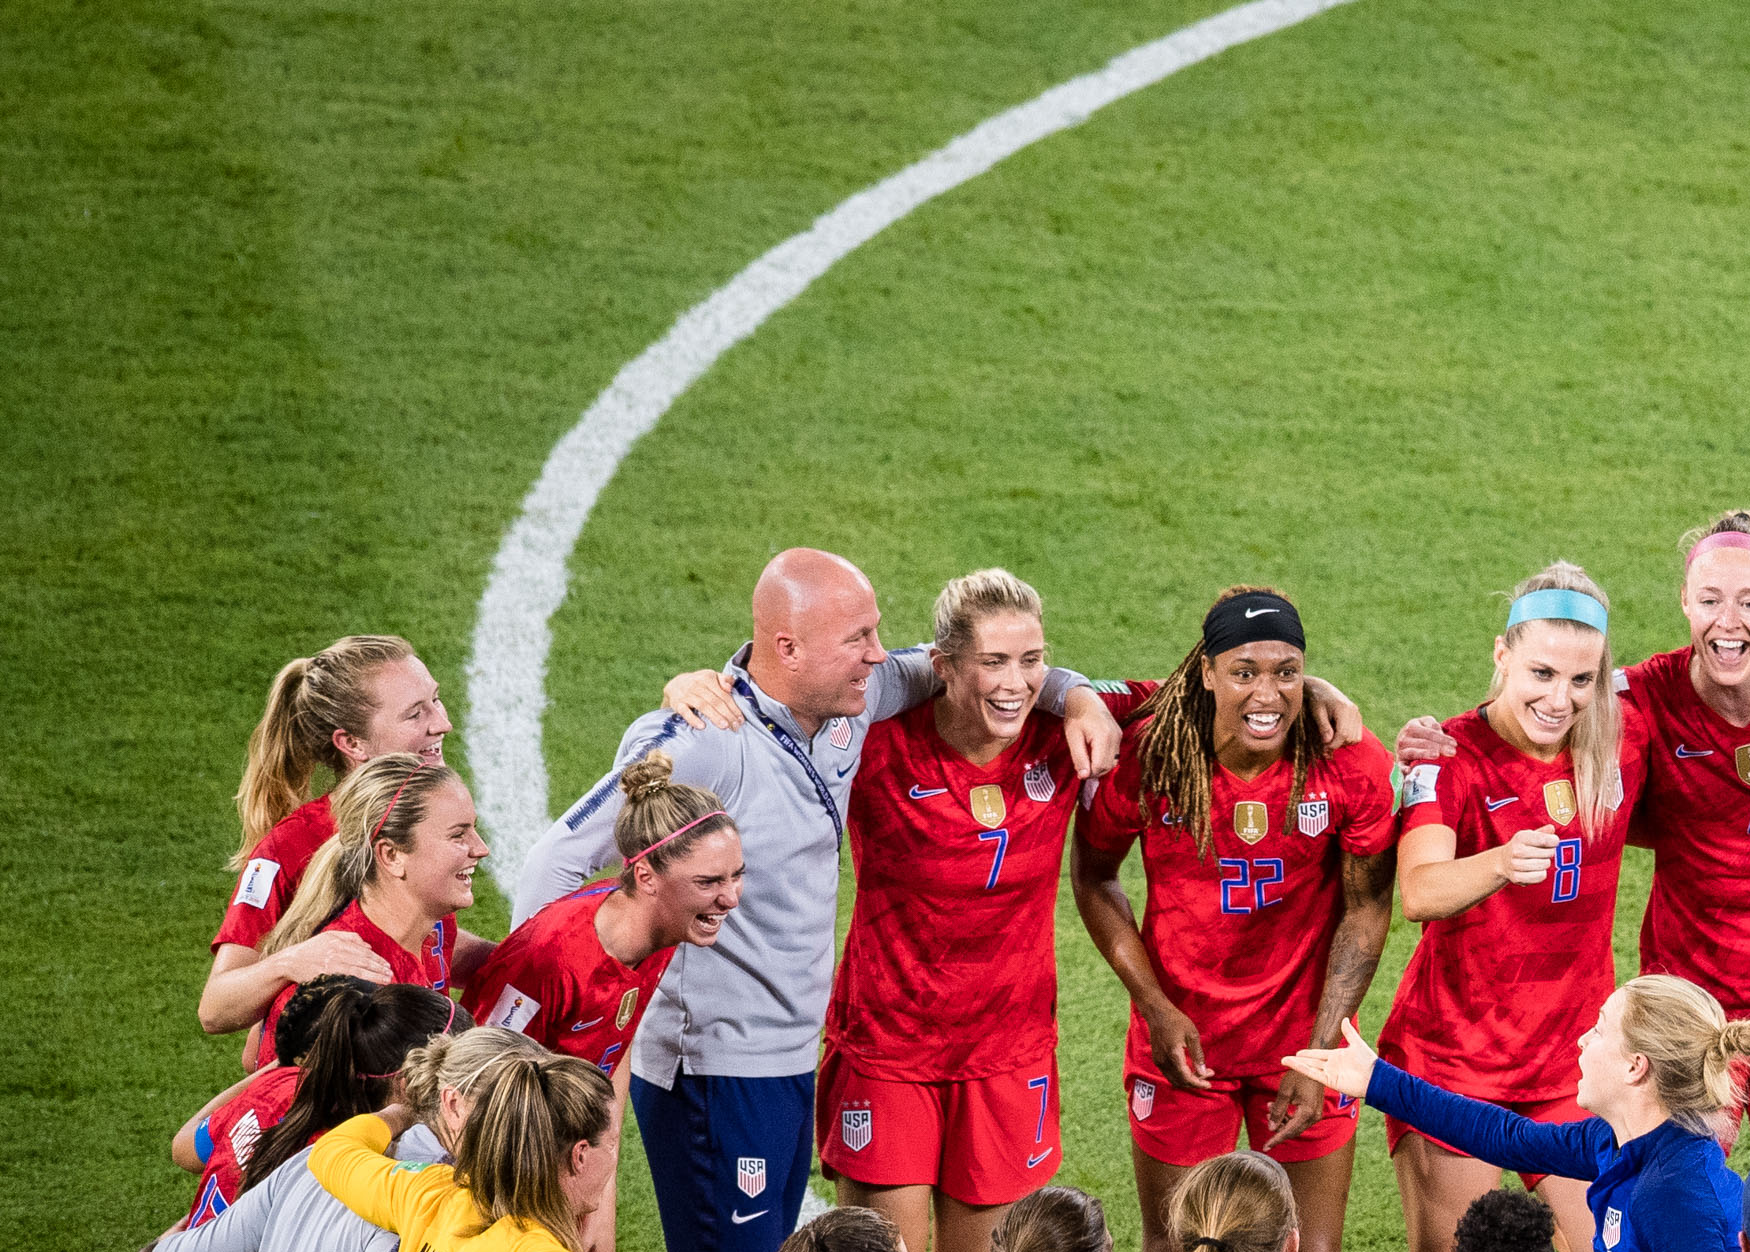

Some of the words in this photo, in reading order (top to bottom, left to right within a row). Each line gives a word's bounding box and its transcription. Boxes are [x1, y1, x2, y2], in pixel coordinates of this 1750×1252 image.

[1300, 803, 1327, 818] USA
[978, 828, 1009, 890] 7
[1551, 837, 1582, 903] 8
[1219, 858, 1284, 915] 22
[1135, 1080, 1154, 1099] USA
[844, 1112, 869, 1128] USA
[1028, 1075, 1049, 1144] 7
[740, 1160, 763, 1175] USA
